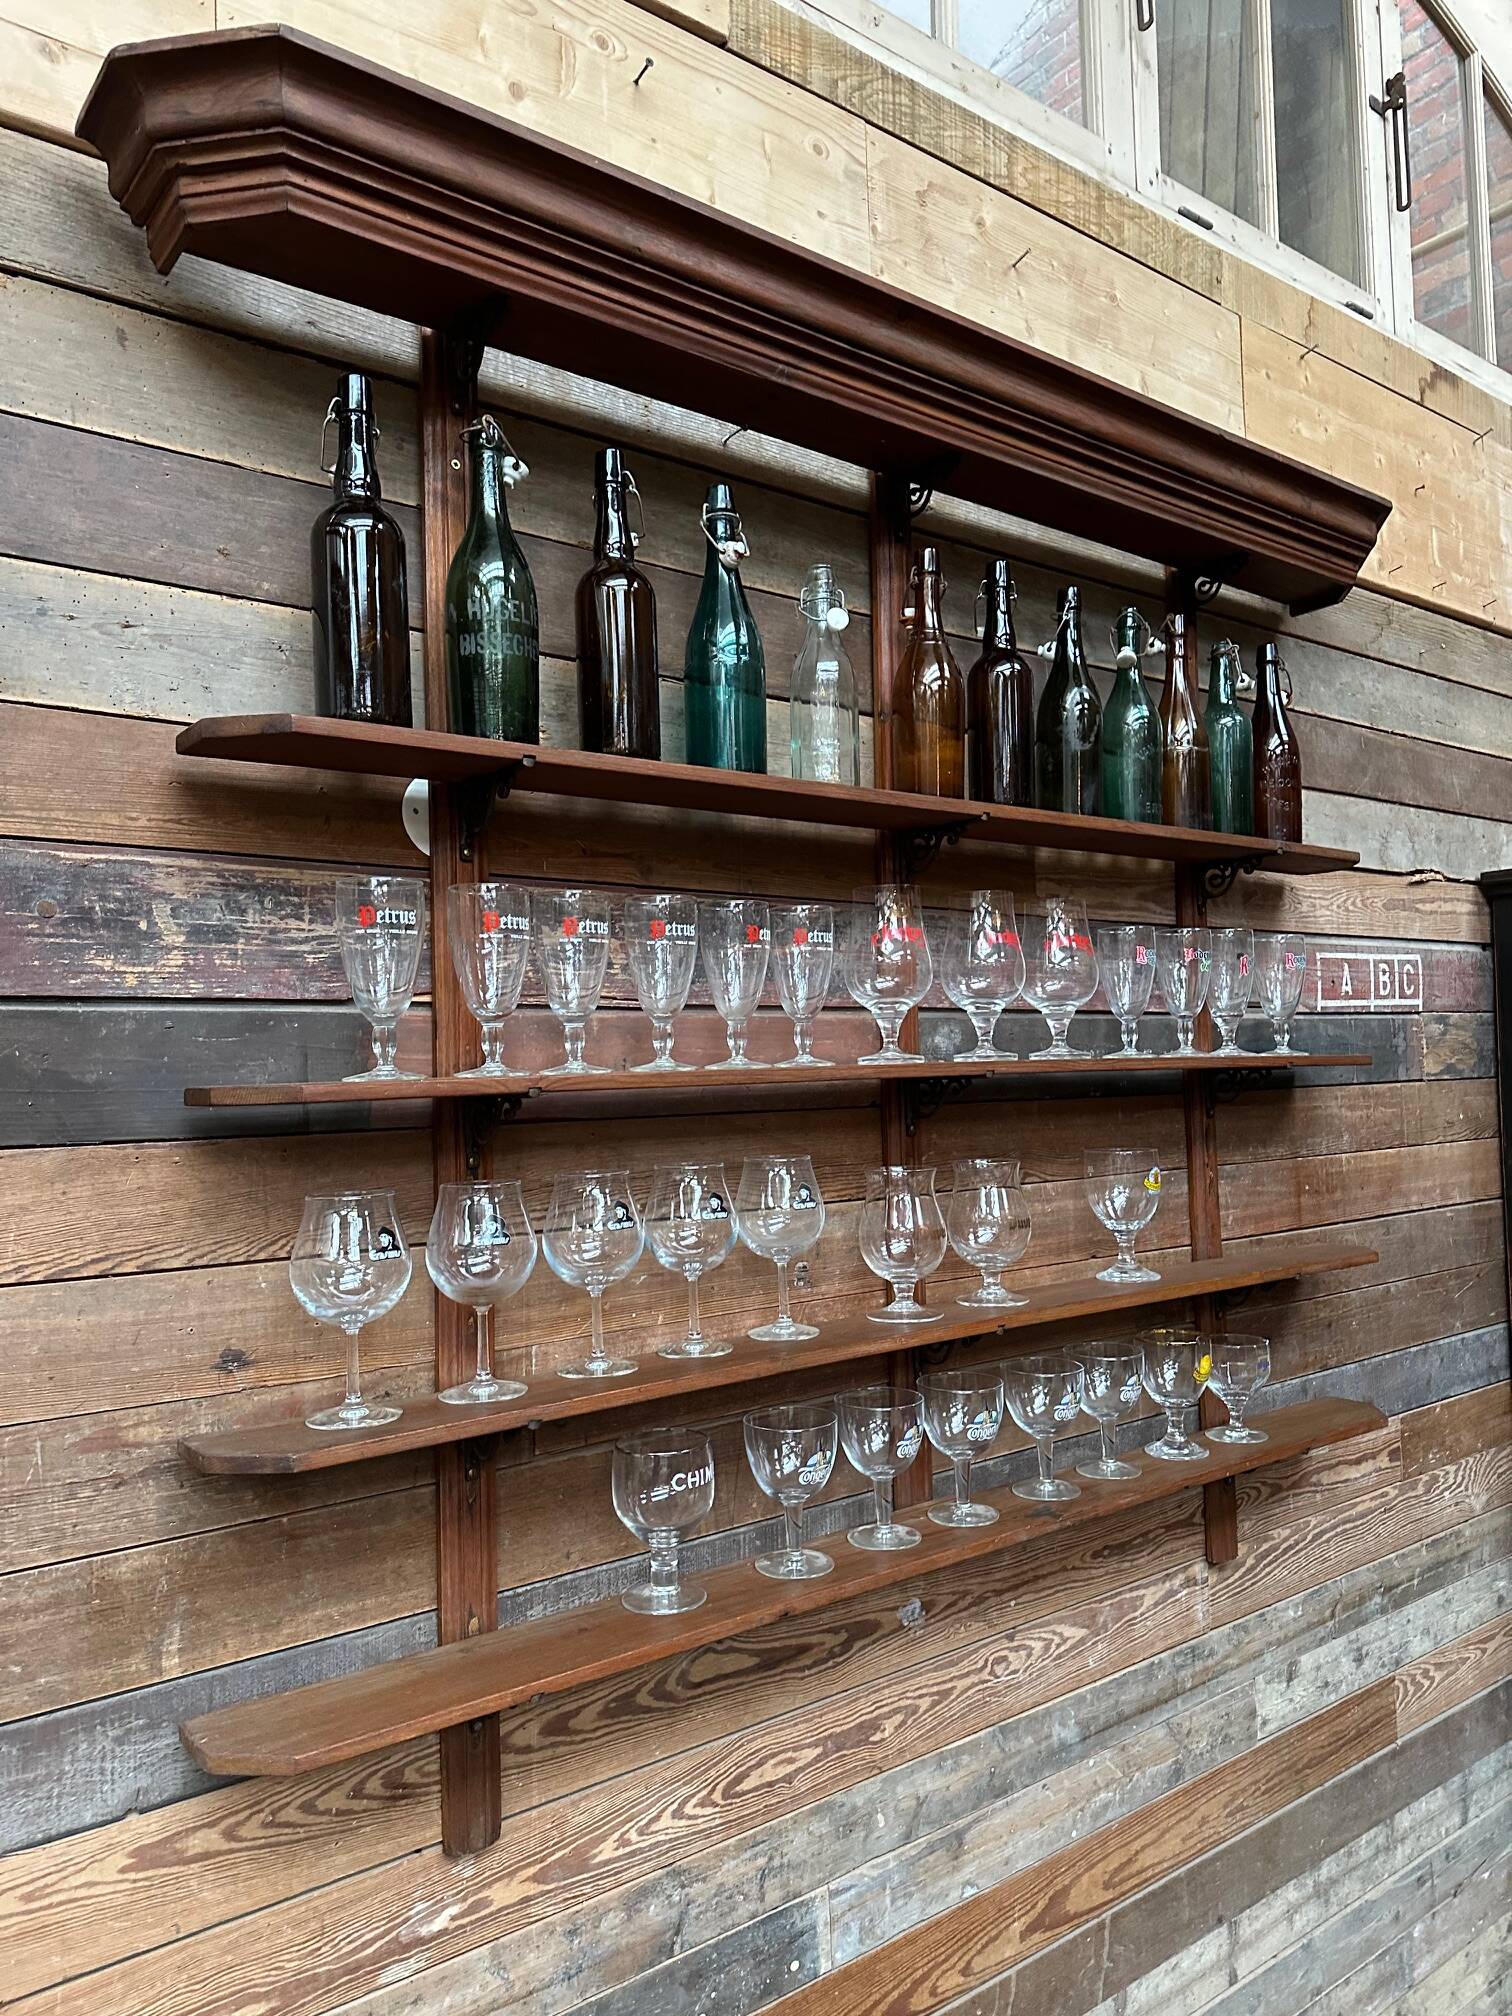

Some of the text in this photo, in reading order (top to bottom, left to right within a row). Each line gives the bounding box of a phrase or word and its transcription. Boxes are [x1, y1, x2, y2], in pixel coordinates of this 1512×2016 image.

[359, 904, 417, 928] Petrus
[482, 911, 530, 933] Petrus
[562, 916, 609, 936] Petrus
[650, 919, 696, 939] Petrus
[1340, 962, 1415, 996] A B C
